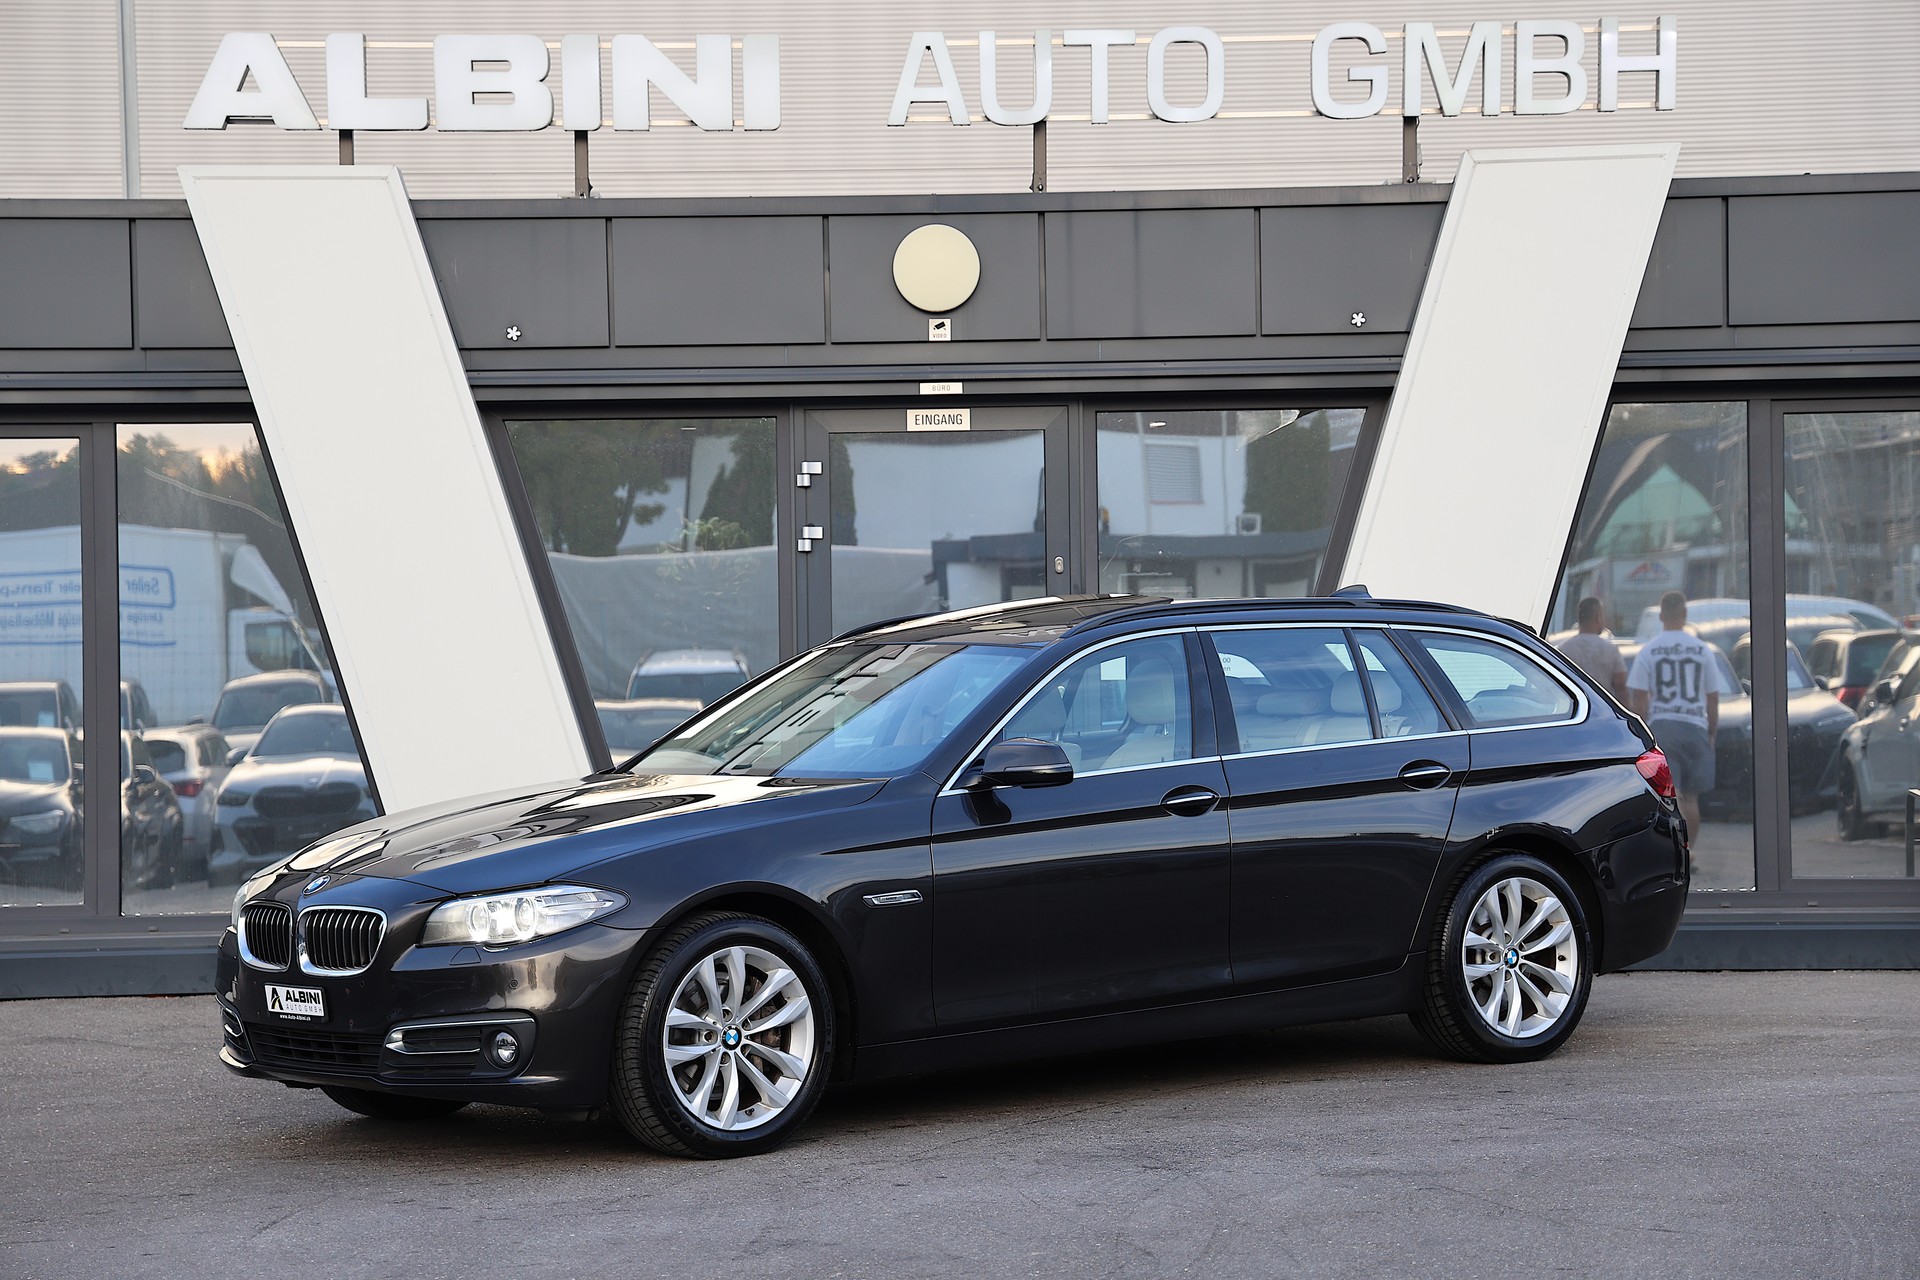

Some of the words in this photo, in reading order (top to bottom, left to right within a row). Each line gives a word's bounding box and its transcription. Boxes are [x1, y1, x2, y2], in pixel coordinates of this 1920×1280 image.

[183, 32, 782, 132] ALBINI
[886, 25, 1225, 127] AUTO
[1310, 15, 1678, 120] GMBH
[914, 413, 963, 426] EINGANG
[286, 990, 320, 1004] ALBINI
